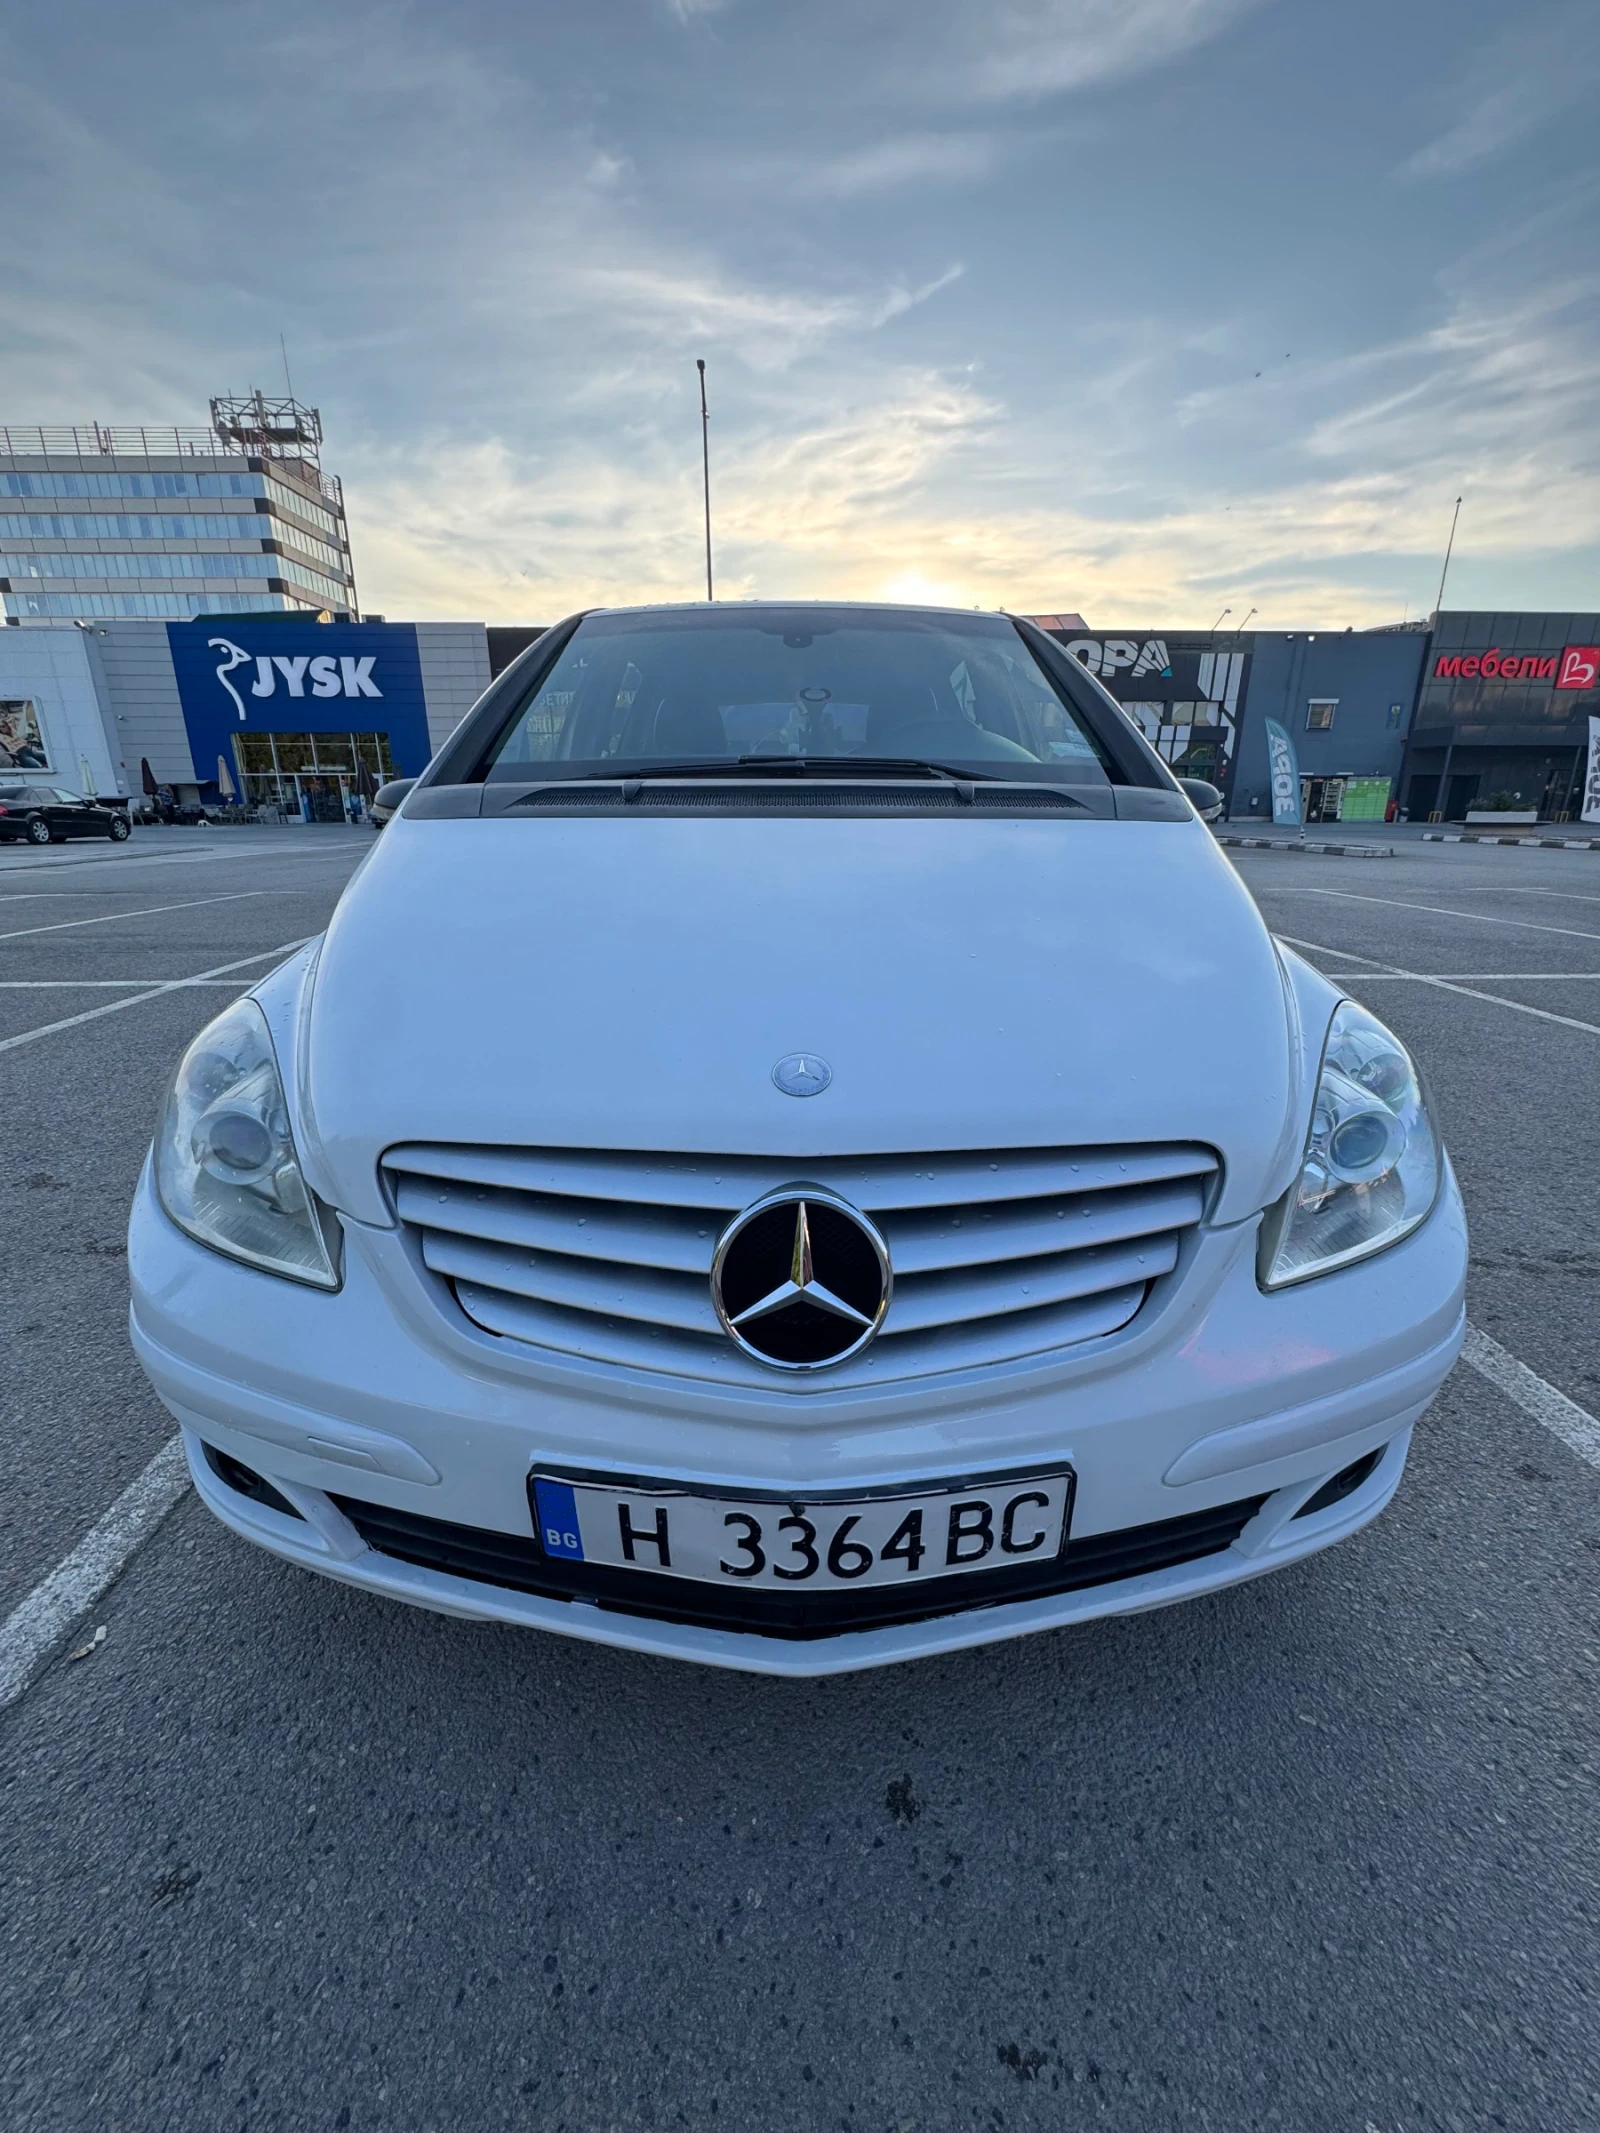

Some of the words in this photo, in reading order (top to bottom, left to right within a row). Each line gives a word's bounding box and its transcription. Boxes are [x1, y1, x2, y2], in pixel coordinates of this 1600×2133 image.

[251, 656, 384, 698] JYSK
[1435, 648, 1556, 678] мебели
[546, 1529, 578, 1549] BG
[618, 1503, 671, 1567] H
[720, 1510, 925, 1580] 3364
[945, 1492, 1050, 1566] BC
